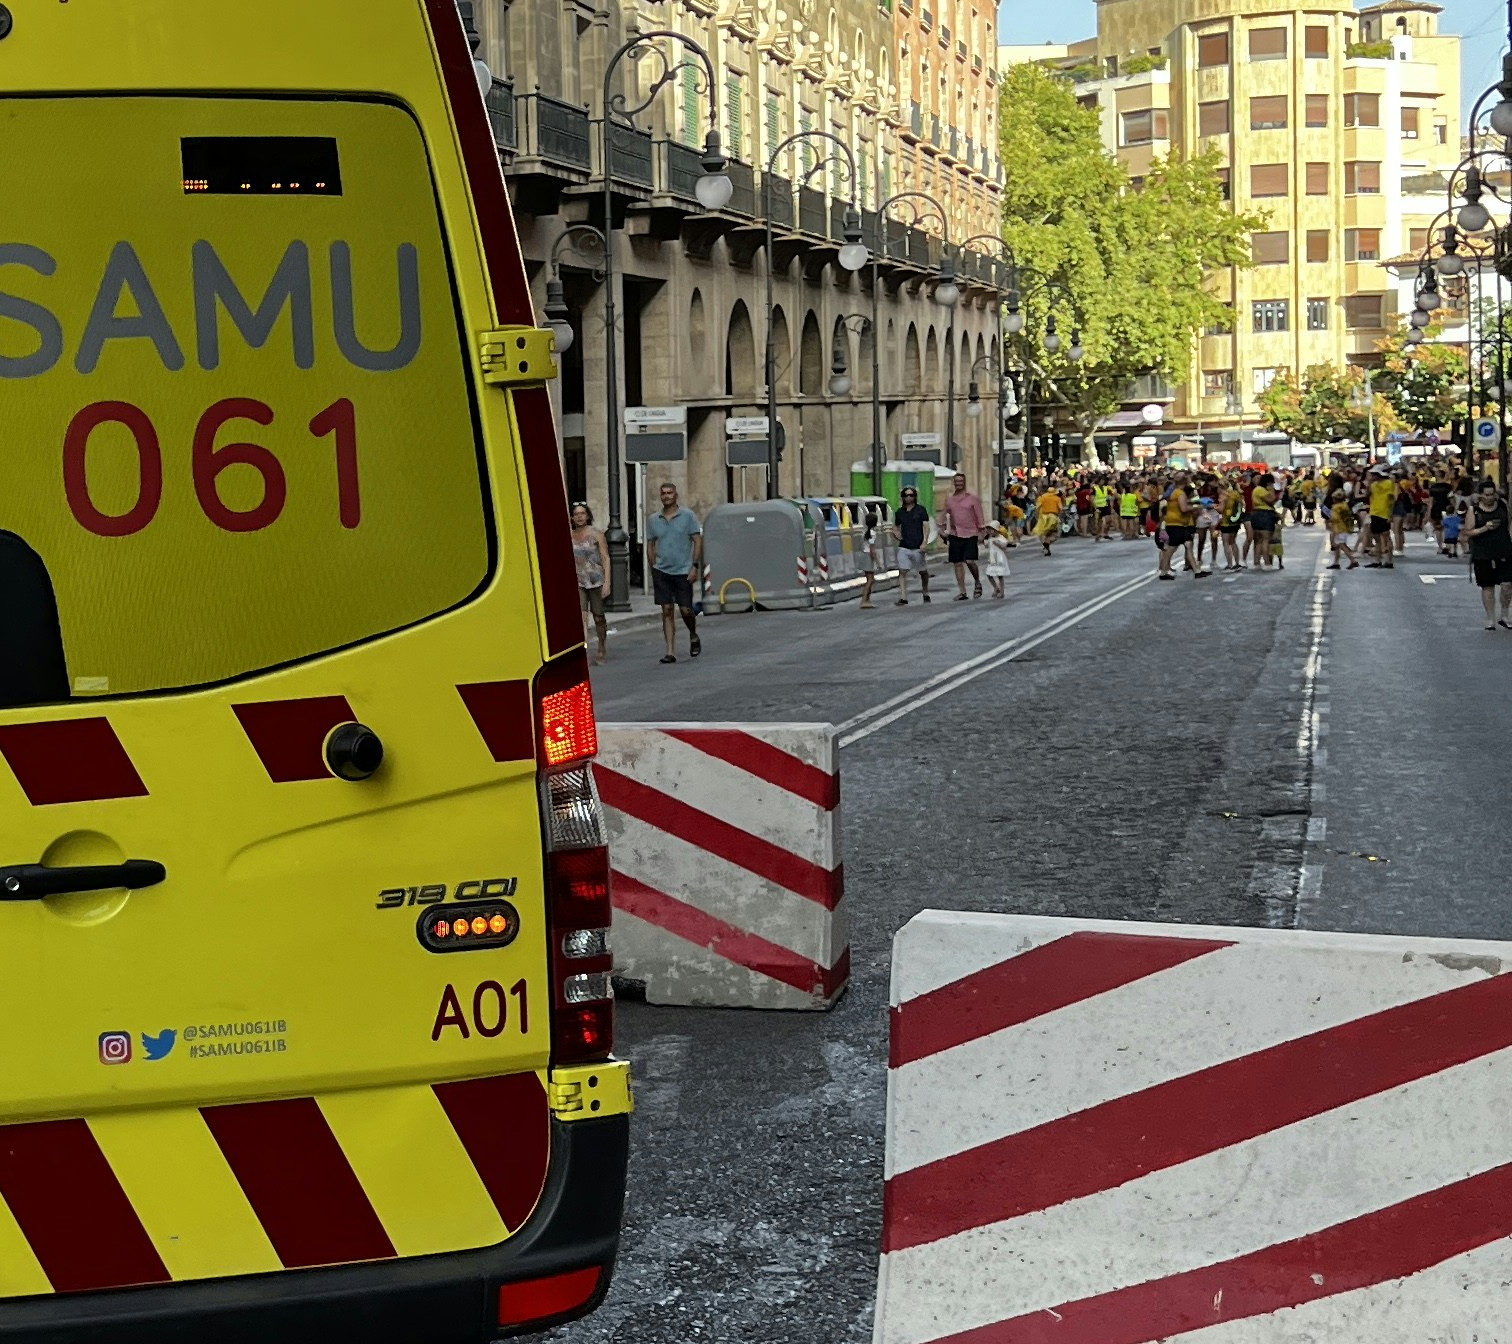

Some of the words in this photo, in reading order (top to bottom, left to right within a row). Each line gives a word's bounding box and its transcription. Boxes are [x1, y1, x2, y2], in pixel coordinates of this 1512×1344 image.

[62, 396, 362, 538] 061
[375, 883, 448, 910] 319
[452, 876, 519, 902] CDI
[431, 978, 529, 1042] A01
